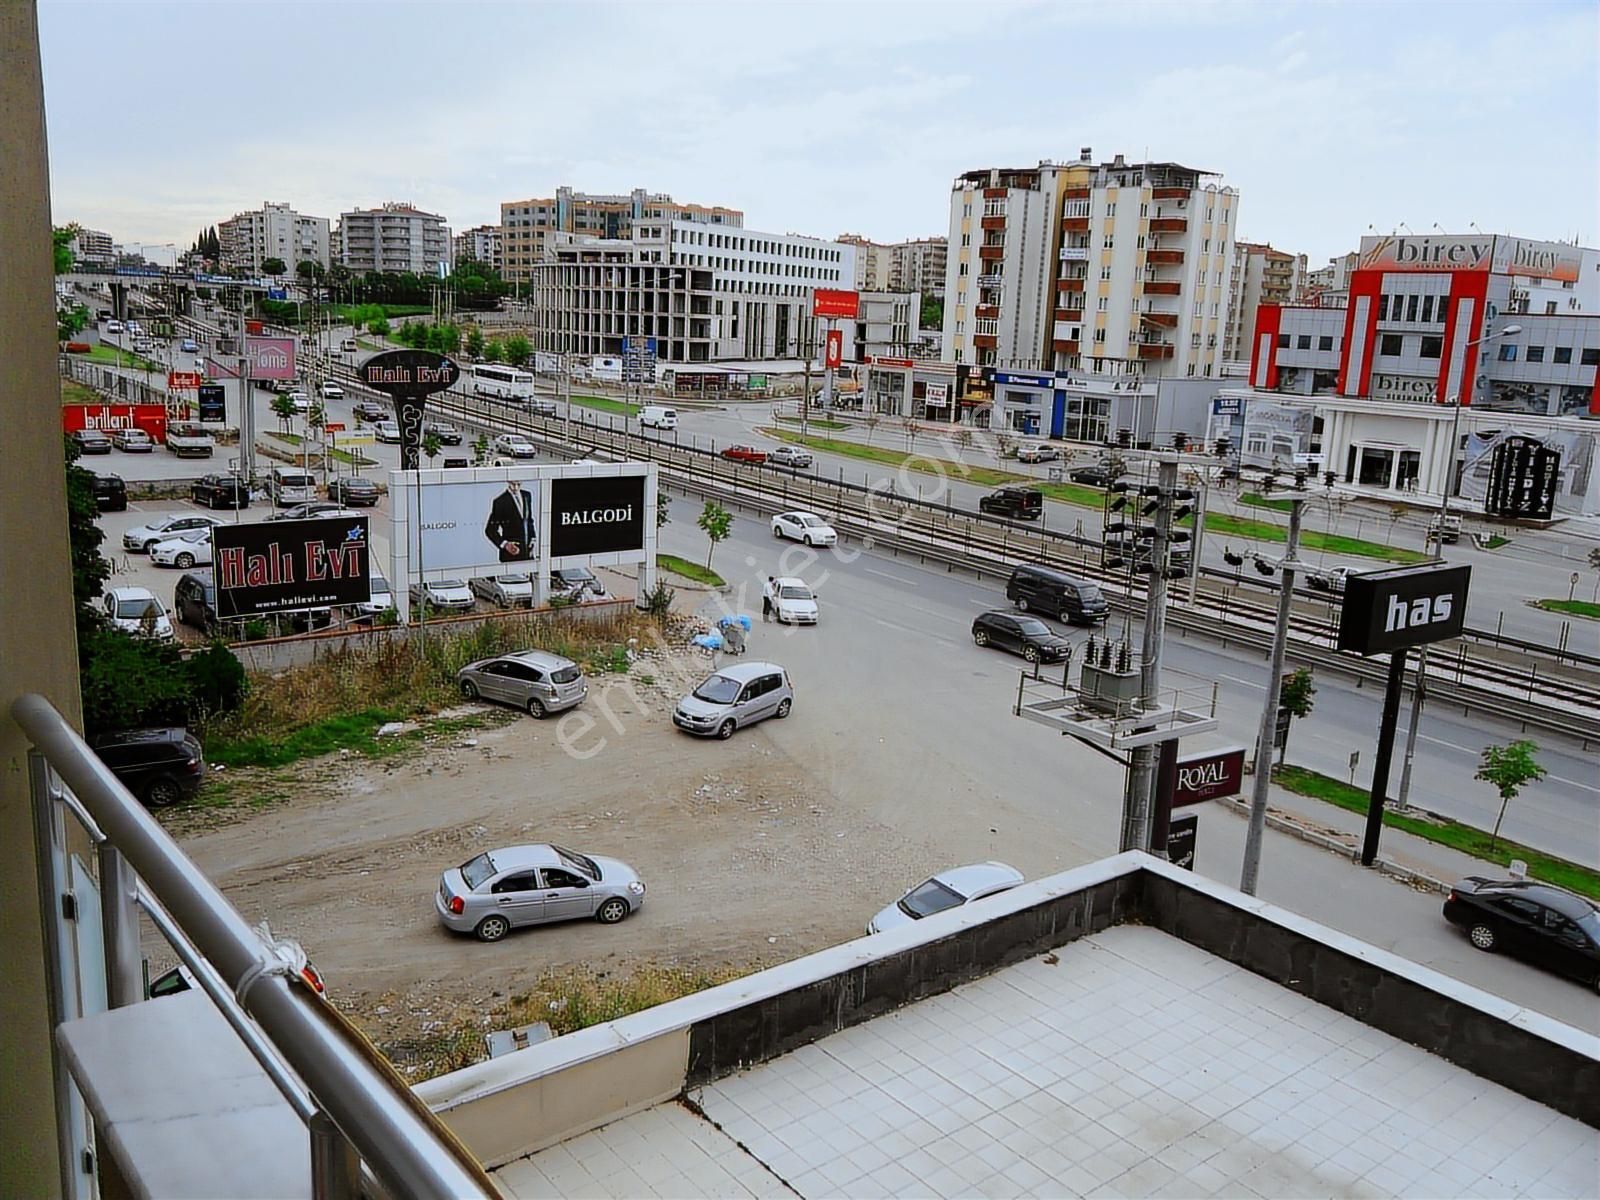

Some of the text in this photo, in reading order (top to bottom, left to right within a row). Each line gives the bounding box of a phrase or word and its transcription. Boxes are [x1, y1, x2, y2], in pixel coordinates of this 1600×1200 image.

[1396, 238, 1489, 269] birey
[1513, 240, 1560, 275] birey
[368, 366, 453, 382] Halı Evi
[1377, 375, 1438, 397] birey
[561, 503, 633, 526] BALGODİ
[220, 540, 366, 590] Halı Evi
[1384, 593, 1453, 633] has
[1176, 760, 1230, 791] ROYAL
